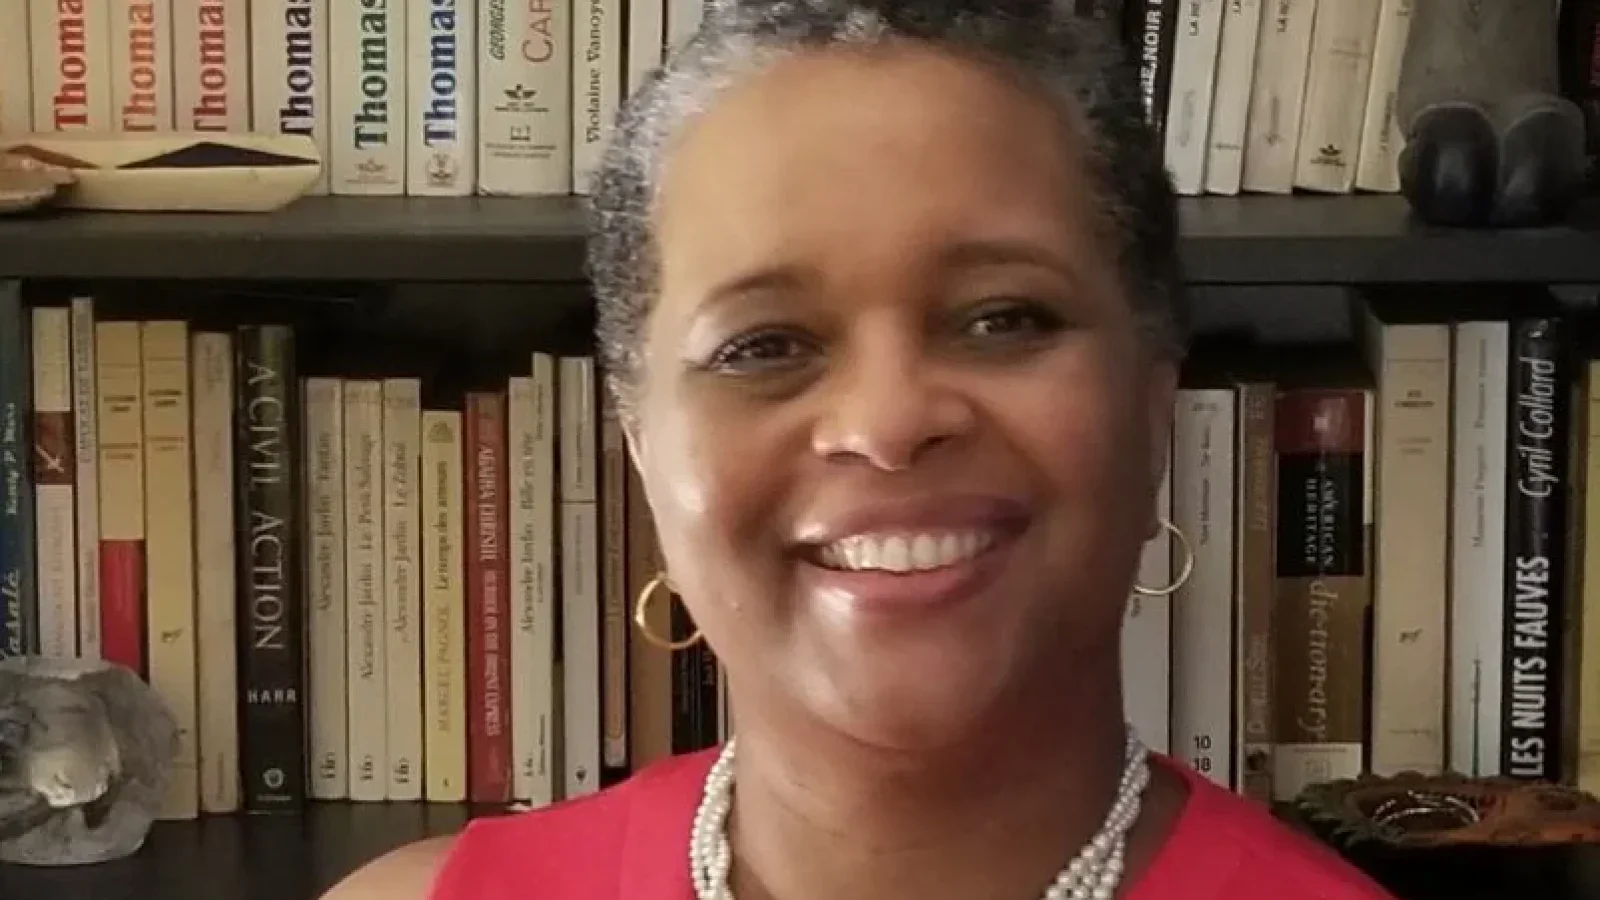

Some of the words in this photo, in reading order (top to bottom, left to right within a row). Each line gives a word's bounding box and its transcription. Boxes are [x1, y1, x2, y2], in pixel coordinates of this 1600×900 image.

[585, 0, 605, 62] Vanoy
[1515, 354, 1556, 439] Collard
[246, 396, 285, 491] CIVIL
[1517, 444, 1560, 498] Cyril
[1304, 477, 1319, 564] HERITAGE
[249, 510, 290, 652] ACTION
[1512, 555, 1551, 650] FAUVES
[1510, 655, 1547, 730] NUITS
[1192, 757, 1212, 773] 18
[1193, 735, 1212, 751] 10
[1509, 736, 1545, 777] LES
